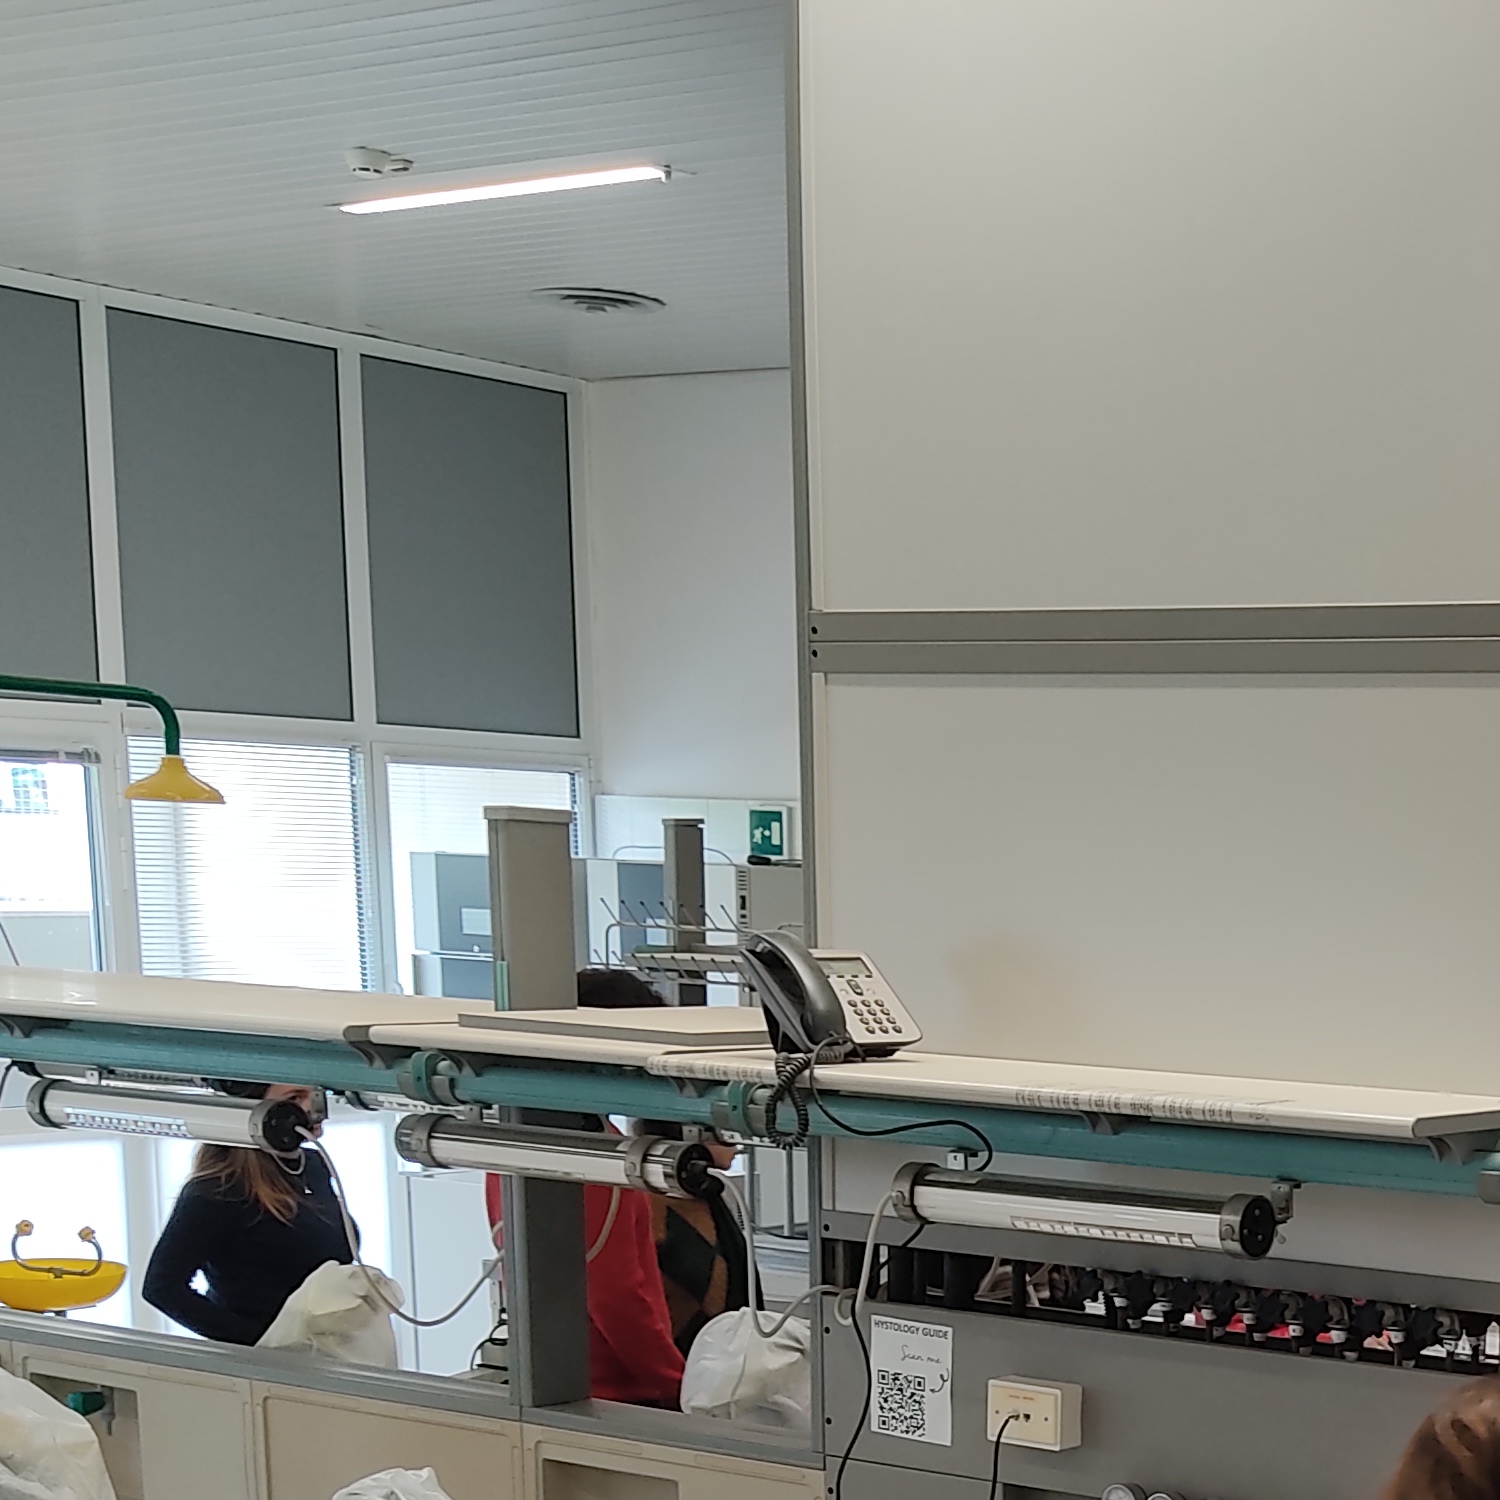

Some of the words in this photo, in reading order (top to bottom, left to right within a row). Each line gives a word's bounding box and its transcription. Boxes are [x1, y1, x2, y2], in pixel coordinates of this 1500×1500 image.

[874, 1319, 920, 1335] HYSTOLOGY
[921, 1327, 949, 1340] GUIDE
[901, 1344, 924, 1361] Scan
[926, 1356, 942, 1364] me
